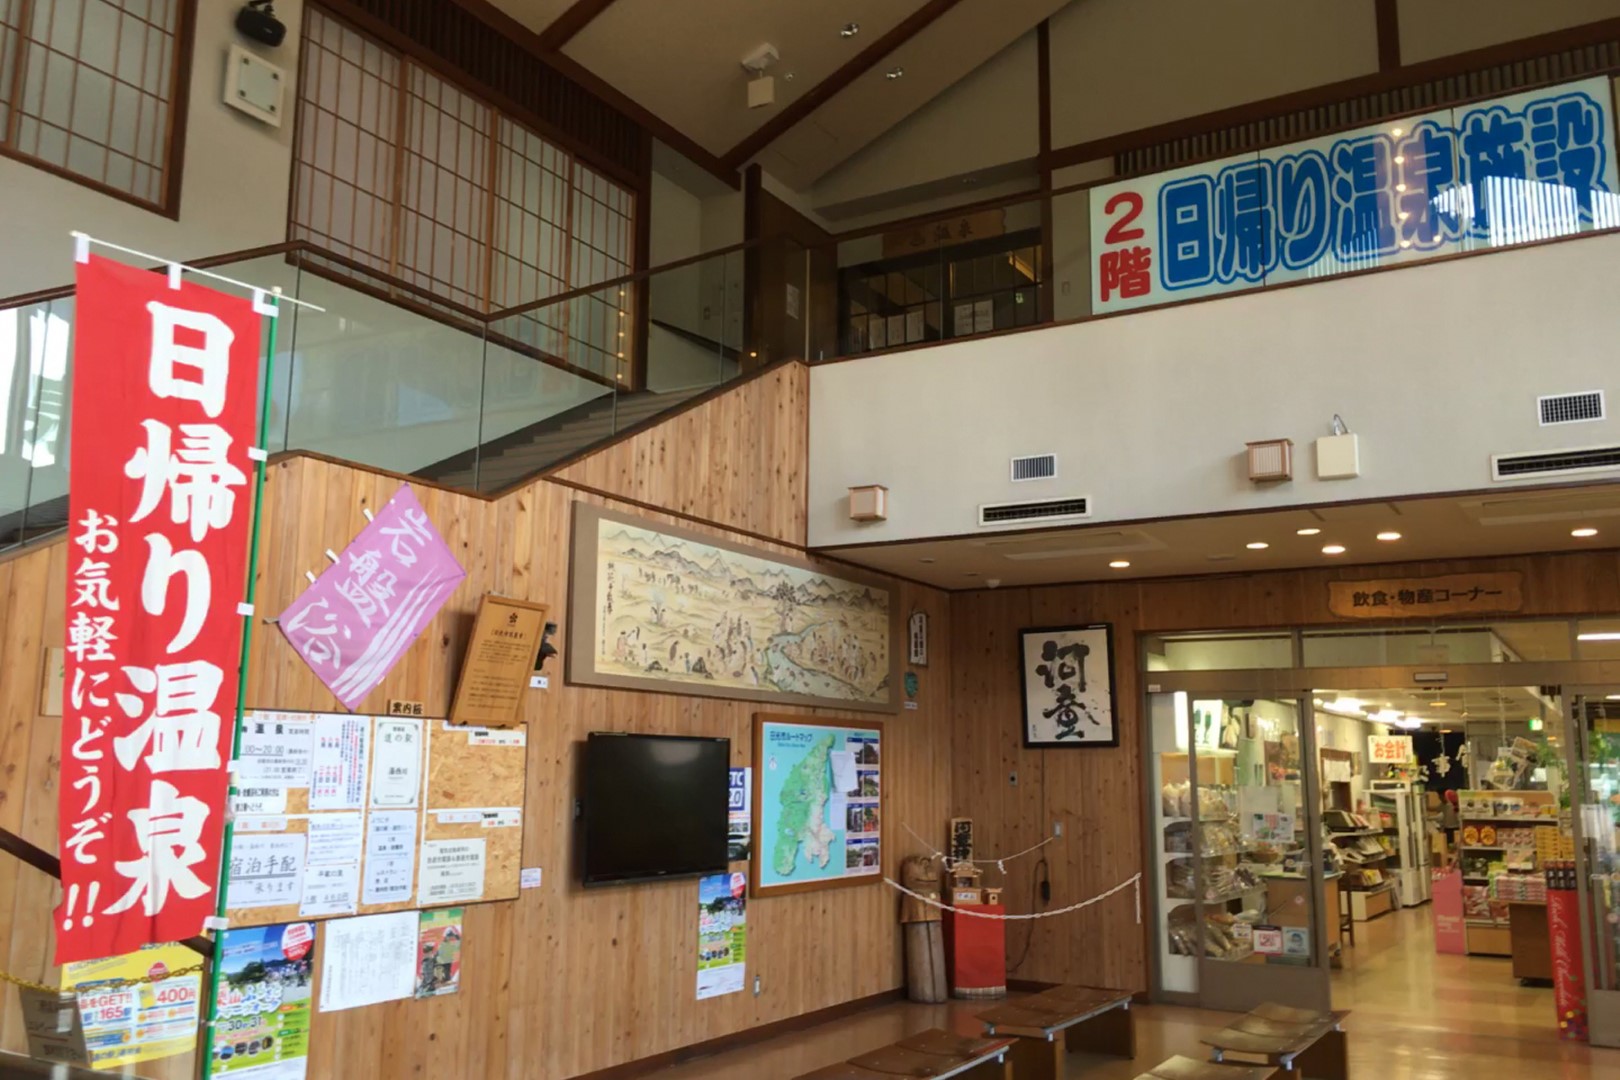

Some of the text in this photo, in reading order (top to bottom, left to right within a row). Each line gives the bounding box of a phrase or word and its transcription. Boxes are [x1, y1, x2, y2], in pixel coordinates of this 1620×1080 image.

[1157, 92, 1608, 290] 日帰り温泉施設
[1100, 192, 1152, 302] 2階
[102, 301, 248, 917] 日帰り温泉
[286, 506, 434, 669] 岩盤浴
[1353, 586, 1503, 607] 飲食・物産コーナー
[63, 508, 120, 932] お気軽にどうぞ!!
[392, 702, 423, 715] 案内板
[1035, 640, 1101, 740] 河童
[1374, 740, 1407, 760] お会計
[231, 854, 297, 876] 宿泊手配
